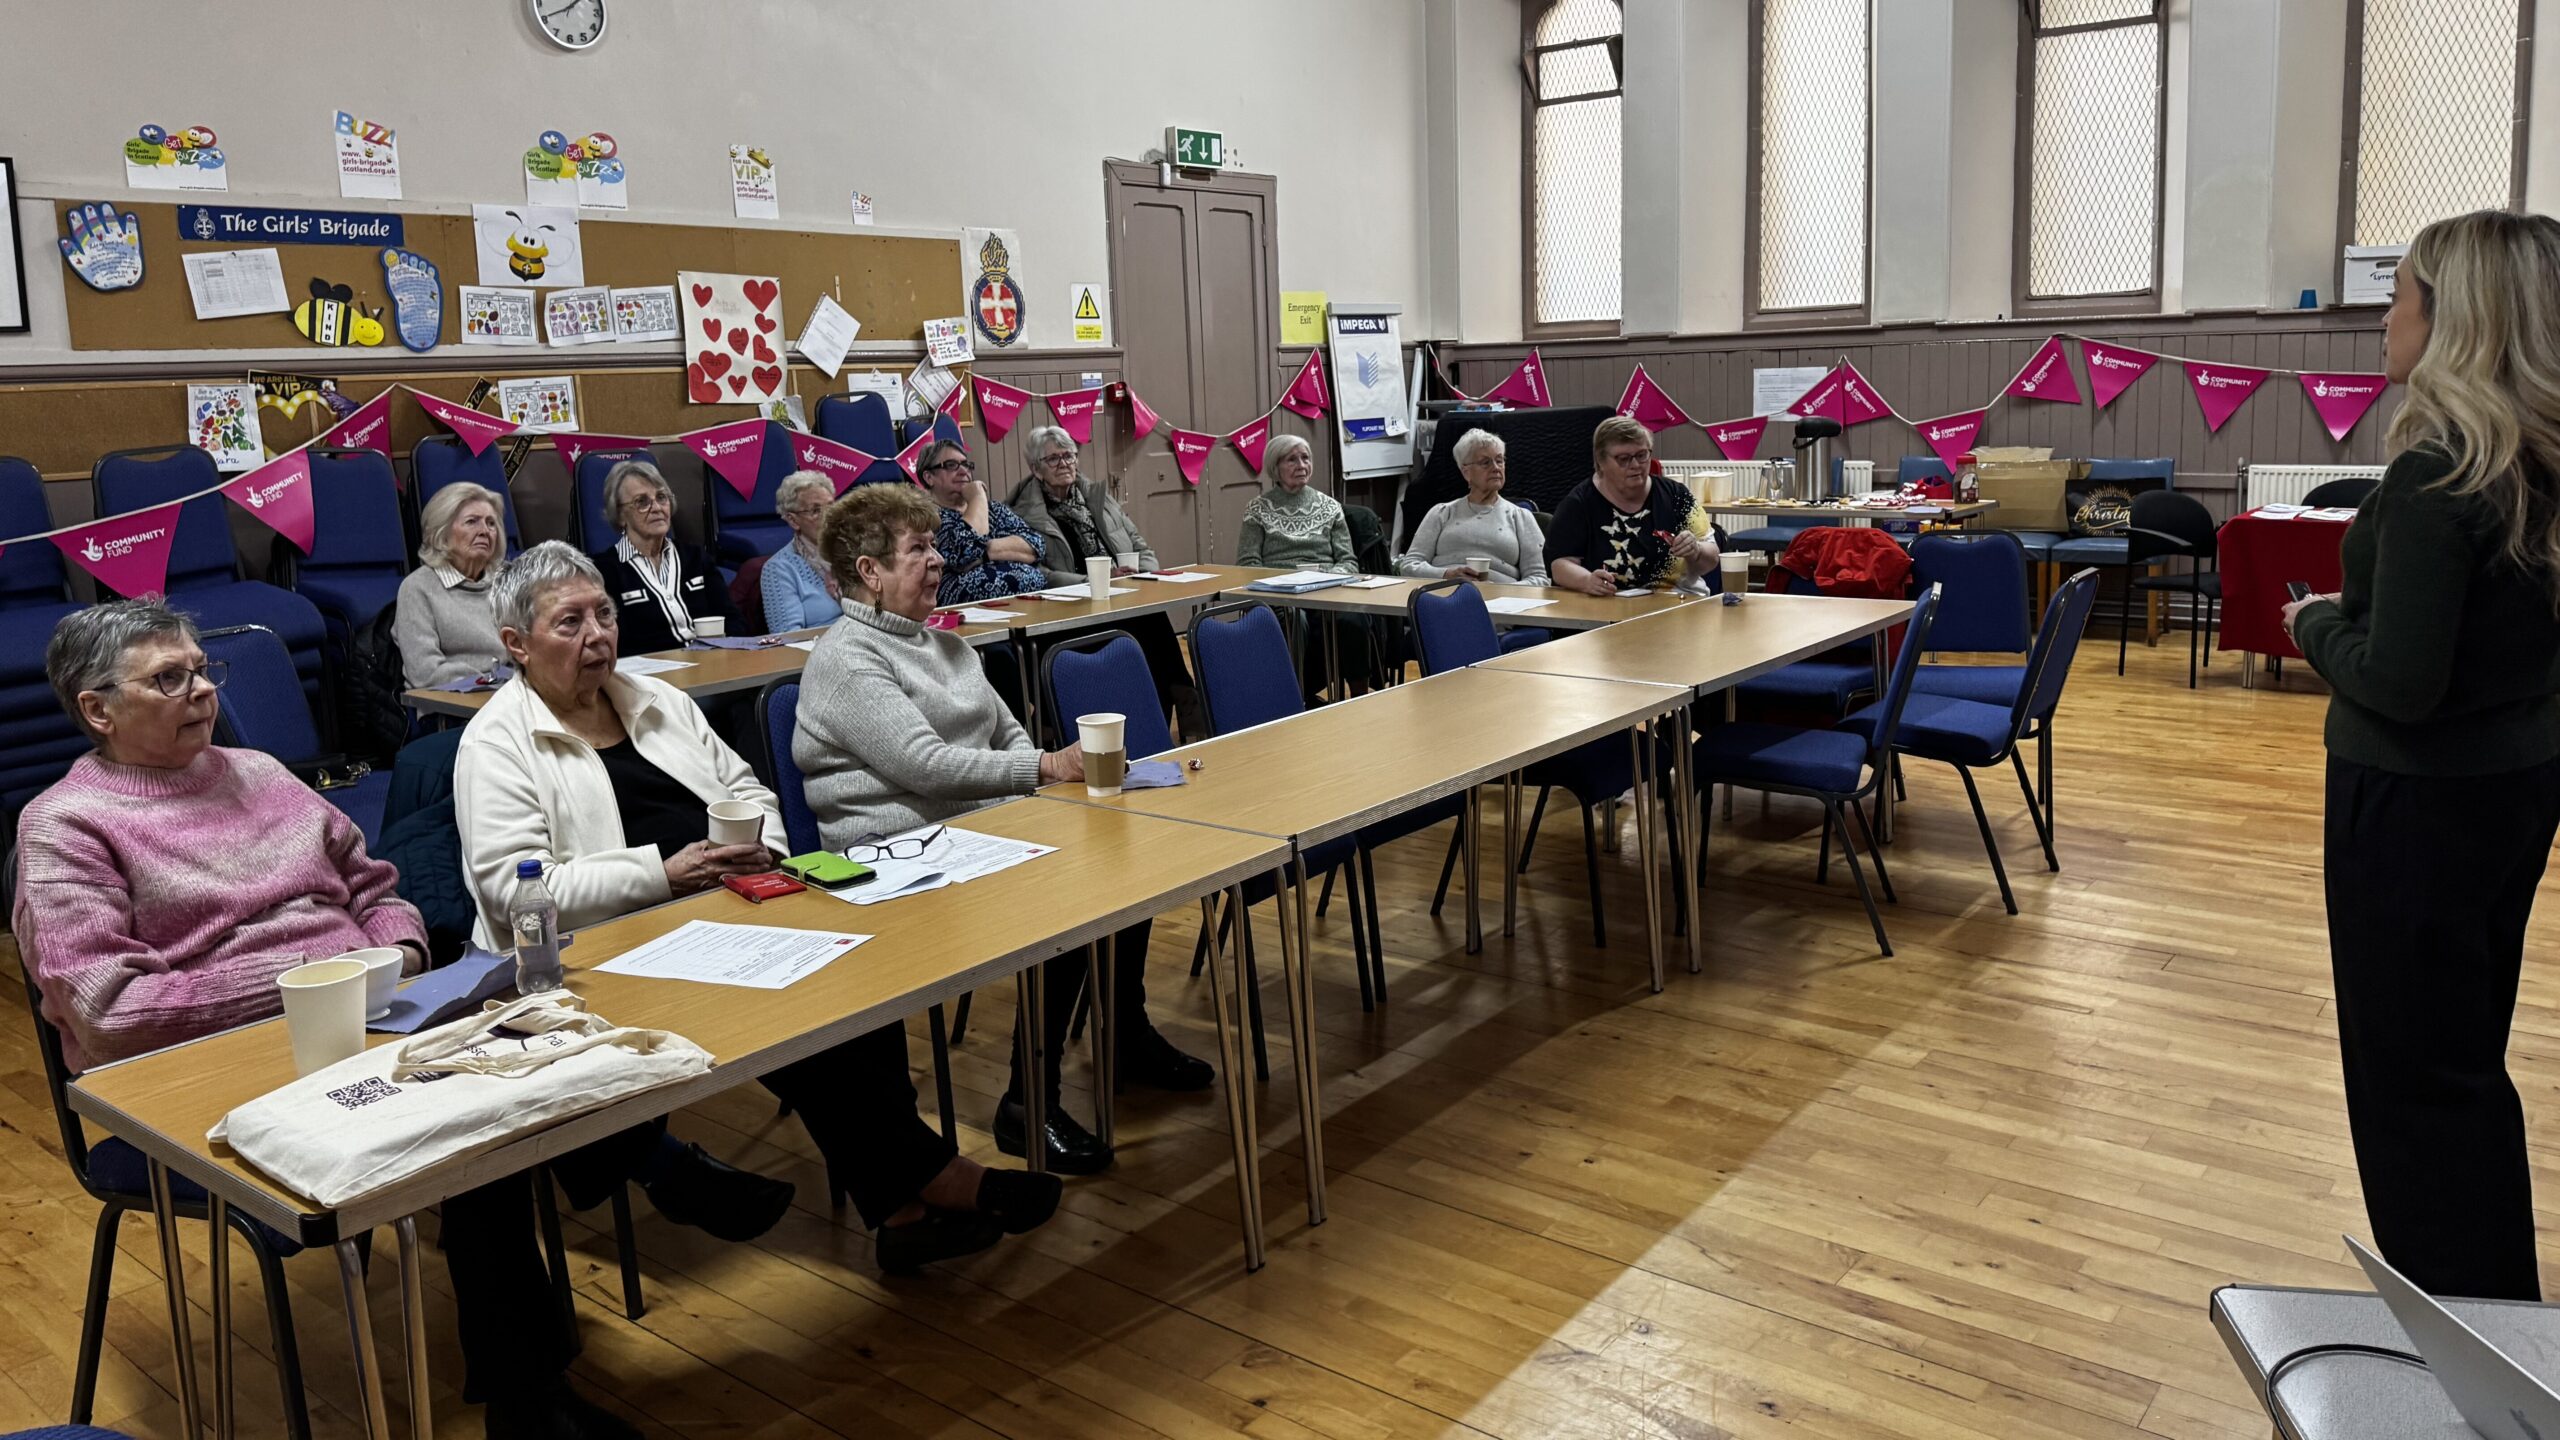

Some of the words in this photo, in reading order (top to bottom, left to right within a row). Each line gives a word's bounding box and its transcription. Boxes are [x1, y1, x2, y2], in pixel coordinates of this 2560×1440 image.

[553, 28, 560, 37] 7
[590, 23, 597, 32] 4
[566, 34, 574, 44] 6
[580, 33, 588, 42] 5
[164, 138, 182, 148] Get
[566, 147, 582, 158] Get
[343, 166, 396, 175] scotland.org.uk
[220, 213, 257, 232] The
[262, 216, 312, 234] Girls'
[319, 218, 390, 240] Brigade
[1288, 303, 1320, 314] Emergency
[1300, 316, 1312, 324] Exit
[2032, 352, 2058, 382] COMMUNITY
[2103, 362, 2118, 370] FUND
[2104, 356, 2142, 370] COMMUNITY
[2035, 372, 2048, 386] FUND
[2210, 376, 2252, 387] COMMUNITY
[1630, 381, 1644, 410] COMMUNITY
[1812, 383, 1838, 406] COMMUNITY
[992, 395, 1020, 408] COMMUNITY
[1066, 402, 1092, 410] COMMUNITY
[1852, 388, 1876, 414] COMMUNITY
[354, 416, 384, 440] COMMUNITY
[1246, 428, 1264, 440] COMMUNITY
[1728, 428, 1758, 437] COMMUNITY
[1940, 424, 1974, 434] COMMUNITY
[356, 434, 370, 448] FUND
[718, 434, 758, 449] COMMUNITY
[720, 446, 737, 455] FUND
[816, 460, 833, 470] FUND
[817, 454, 858, 472] COMMUNITY
[262, 471, 303, 497] COMMUNITY
[266, 490, 284, 504] FUND
[2074, 504, 2131, 523] Christm
[104, 528, 165, 550] COMMUNITY
[106, 546, 132, 558] FUND
